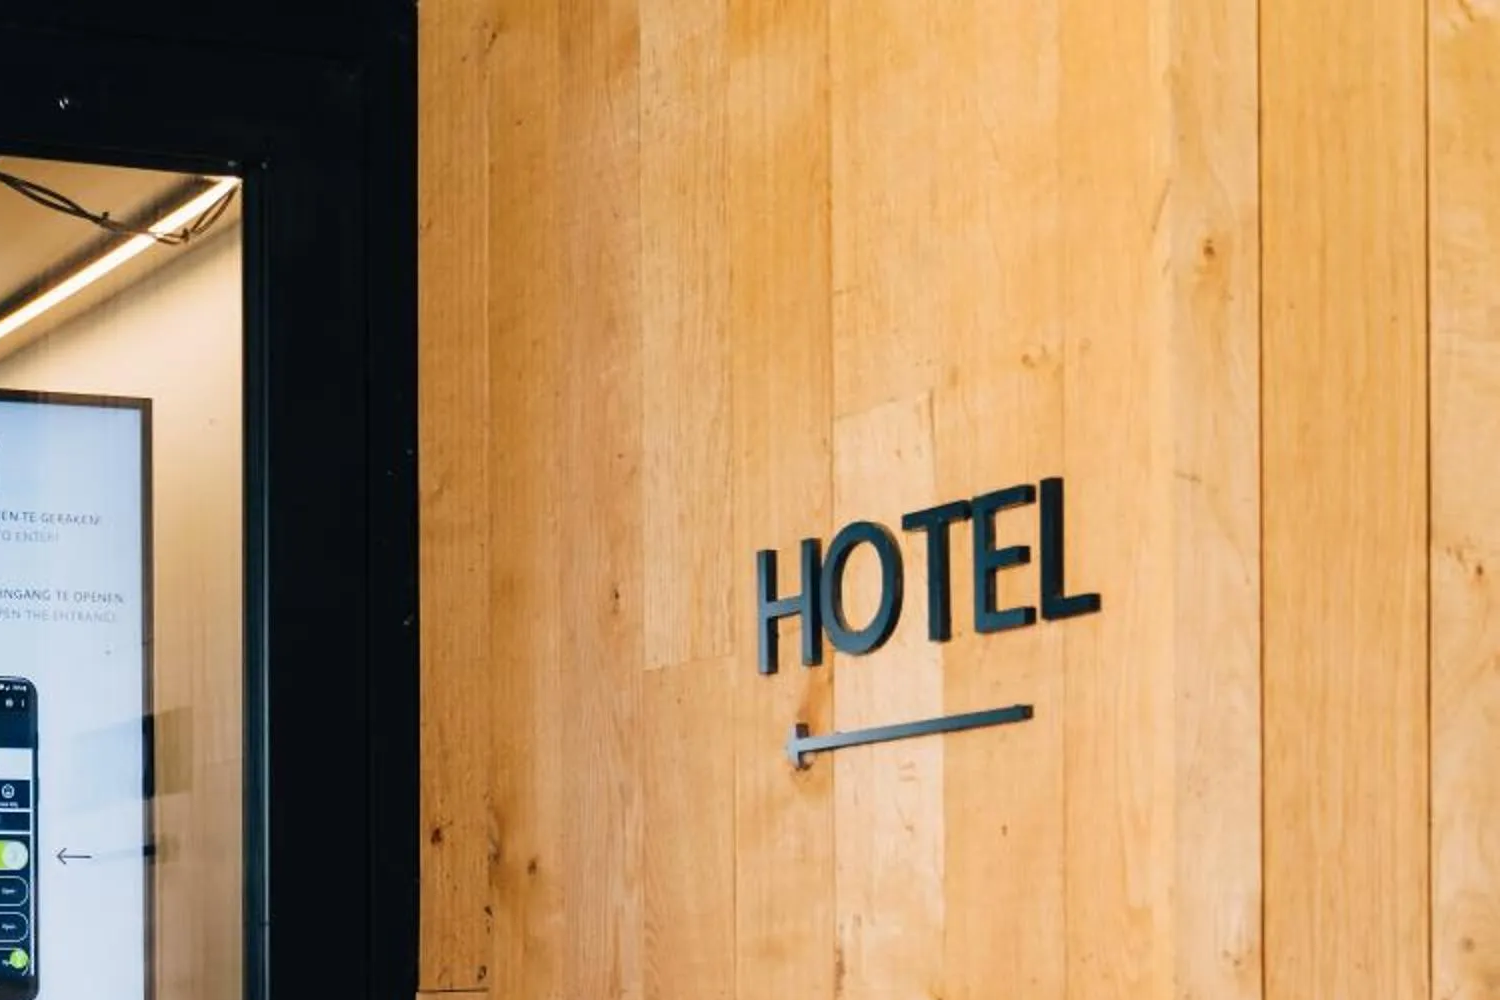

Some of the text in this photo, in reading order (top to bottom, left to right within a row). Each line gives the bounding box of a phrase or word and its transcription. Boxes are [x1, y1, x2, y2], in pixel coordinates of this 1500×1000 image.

[22, 511, 35, 523] TE
[756, 476, 1102, 676] HOTEL
[0, 588, 51, 601] INGANG
